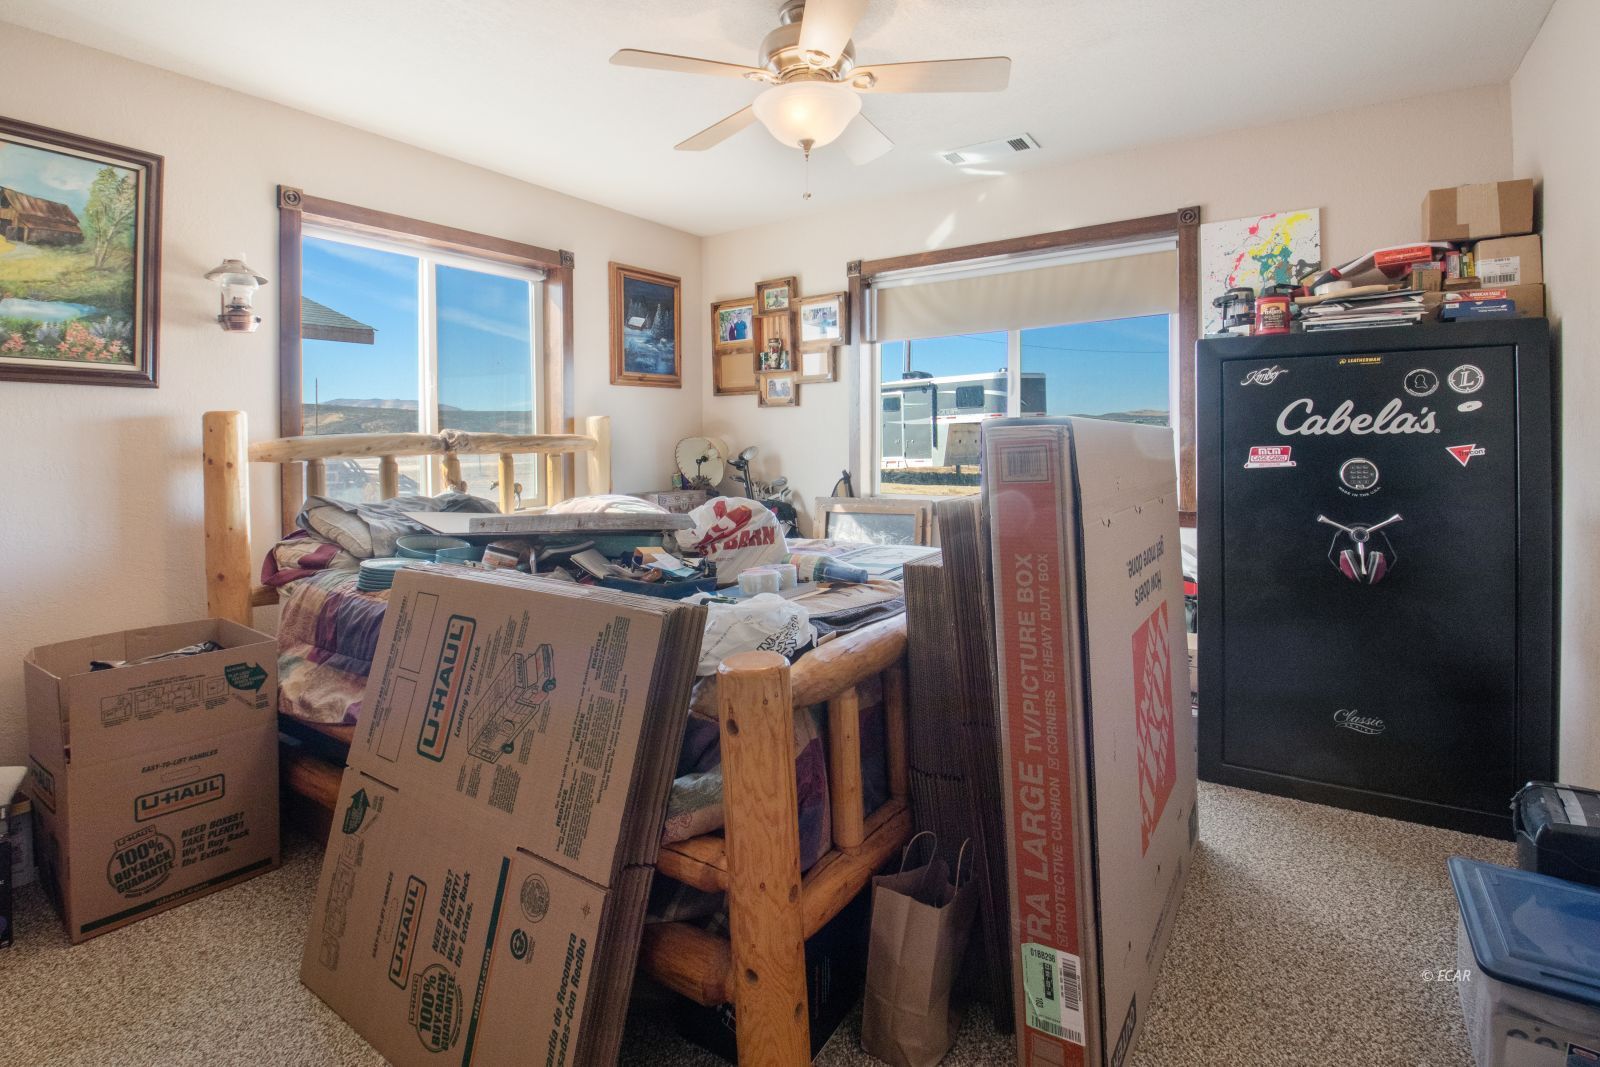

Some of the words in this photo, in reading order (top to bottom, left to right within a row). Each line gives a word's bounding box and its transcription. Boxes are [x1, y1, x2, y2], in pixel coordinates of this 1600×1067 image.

[1276, 398, 1437, 435] Cabela's
[1015, 554, 1034, 602] BOX
[1036, 554, 1049, 581] BOX
[1038, 585, 1051, 621] DUTY
[1039, 625, 1053, 668] HEAVY
[422, 622, 465, 748] U-HAUL
[454, 698, 469, 737] Loading
[463, 673, 473, 695] Your
[469, 644, 480, 671] Truck
[1017, 611, 1042, 754] TV/PICTURE
[1043, 689, 1058, 754] CORNERS
[1333, 709, 1384, 727] Classic
[140, 779, 220, 811] U-HAUL
[555, 789, 569, 827] REDUCE
[1018, 761, 1048, 880] LARGE
[1048, 777, 1062, 840] CUSHION
[181, 824, 207, 838] NEED
[209, 812, 245, 830] BOXES?
[182, 834, 204, 849] TAKE
[113, 849, 173, 884] BUY-BACK
[116, 835, 164, 869] 100%
[431, 918, 445, 953] NEED
[439, 869, 455, 917] BOXES?
[452, 901, 465, 928] Buy
[460, 870, 471, 901] Back
[1051, 842, 1067, 930] PROTECTIVE
[392, 883, 419, 979] U-HAUL
[438, 923, 452, 957] TAKE
[446, 873, 461, 923] PLENTY!
[1024, 893, 1051, 942] RA
[455, 947, 464, 968] the
[473, 947, 492, 1020] uhaul.com
[557, 932, 577, 1005] Recompra
[571, 938, 588, 990] Recibo
[419, 975, 438, 1033] 100%
[431, 972, 447, 1047] BUY-BACK
[554, 1007, 563, 1027] de
